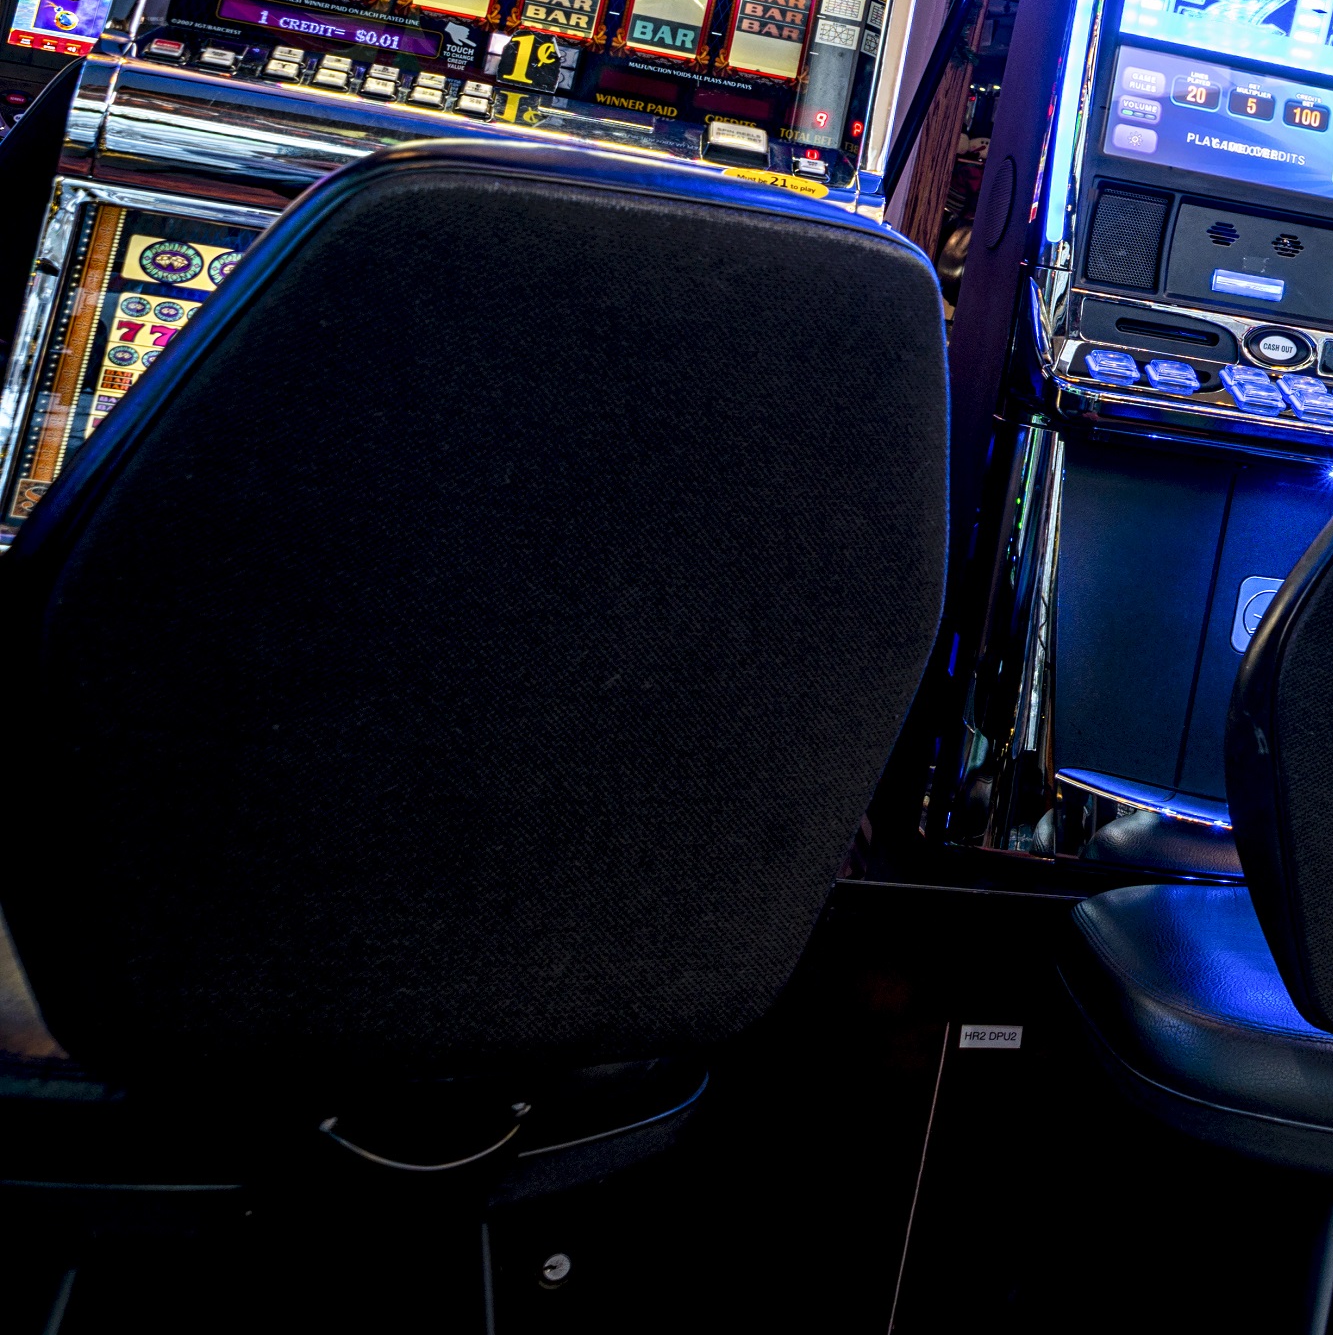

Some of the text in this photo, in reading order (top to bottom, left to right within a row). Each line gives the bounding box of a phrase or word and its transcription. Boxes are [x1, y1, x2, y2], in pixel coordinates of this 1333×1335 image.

[258, 11, 269, 24] 1
[355, 30, 399, 49] $0.01
[503, 35, 555, 84] 1¢
[596, 93, 678, 117] WINNER PAID
[1263, 342, 1294, 354] CASH OUT
[964, 1032, 1017, 1042] HR2 DPU2
